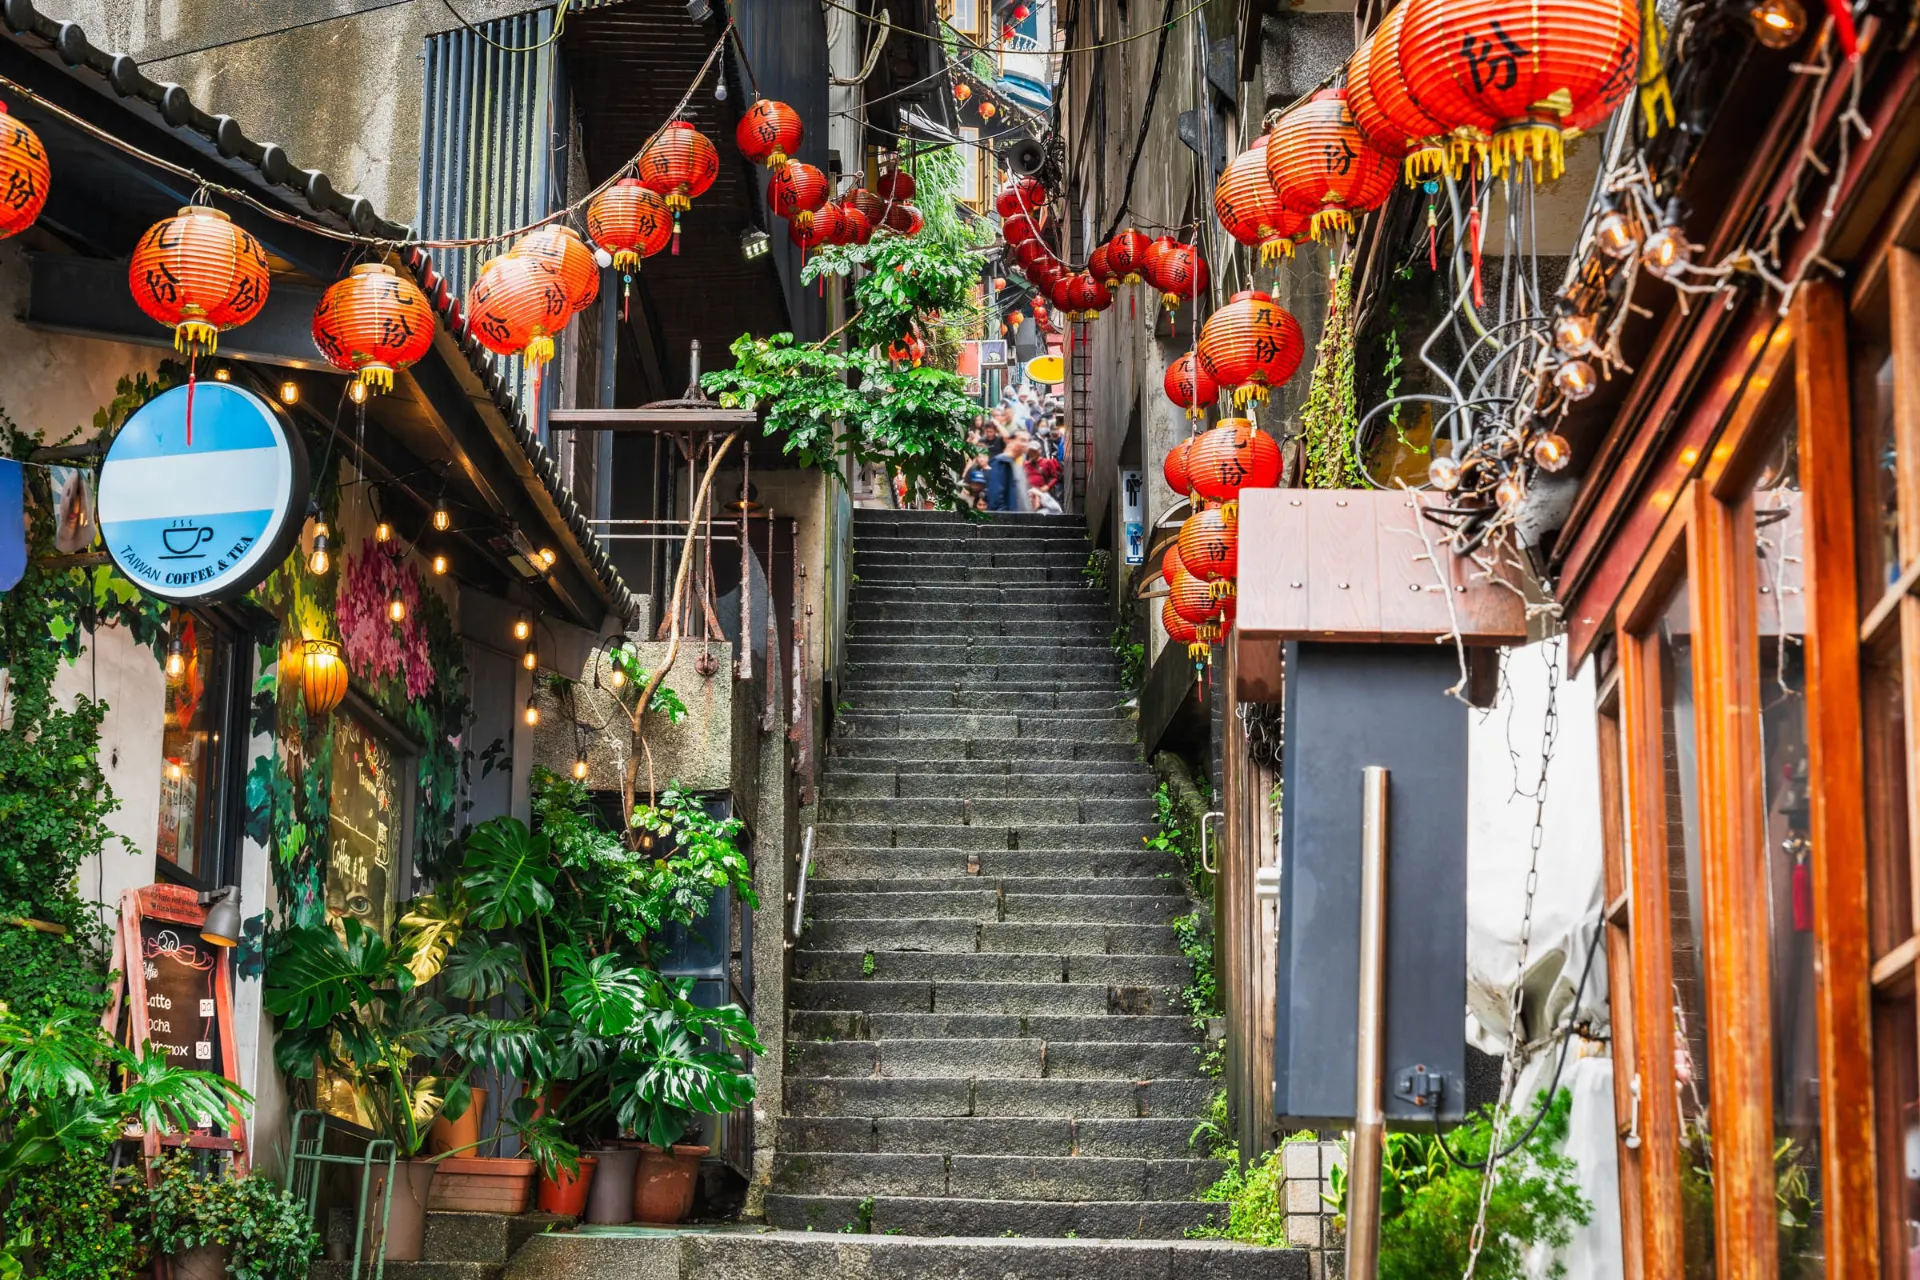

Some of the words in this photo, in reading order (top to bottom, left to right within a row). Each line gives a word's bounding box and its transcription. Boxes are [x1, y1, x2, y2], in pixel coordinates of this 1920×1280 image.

[753, 104, 778, 144] 九份
[1323, 105, 1357, 176] 九份
[4, 127, 41, 210] 九份
[777, 168, 799, 207] 九份
[639, 191, 660, 237] 九份
[145, 220, 181, 304] 九份
[229, 232, 267, 312] 九份
[1117, 235, 1131, 267] 九份
[1175, 252, 1192, 282] 九份
[381, 281, 414, 348] 九份
[473, 283, 511, 344] 九份
[1254, 308, 1282, 364] 九份
[1220, 429, 1248, 487] 九份
[120, 545, 161, 582] TAIWAN
[166, 565, 216, 585] COFFEE
[218, 559, 229, 571] &
[227, 536, 254, 561] TEA
[333, 838, 352, 880] Coffee
[147, 992, 172, 1010] atte
[149, 1017, 172, 1034] ocha
